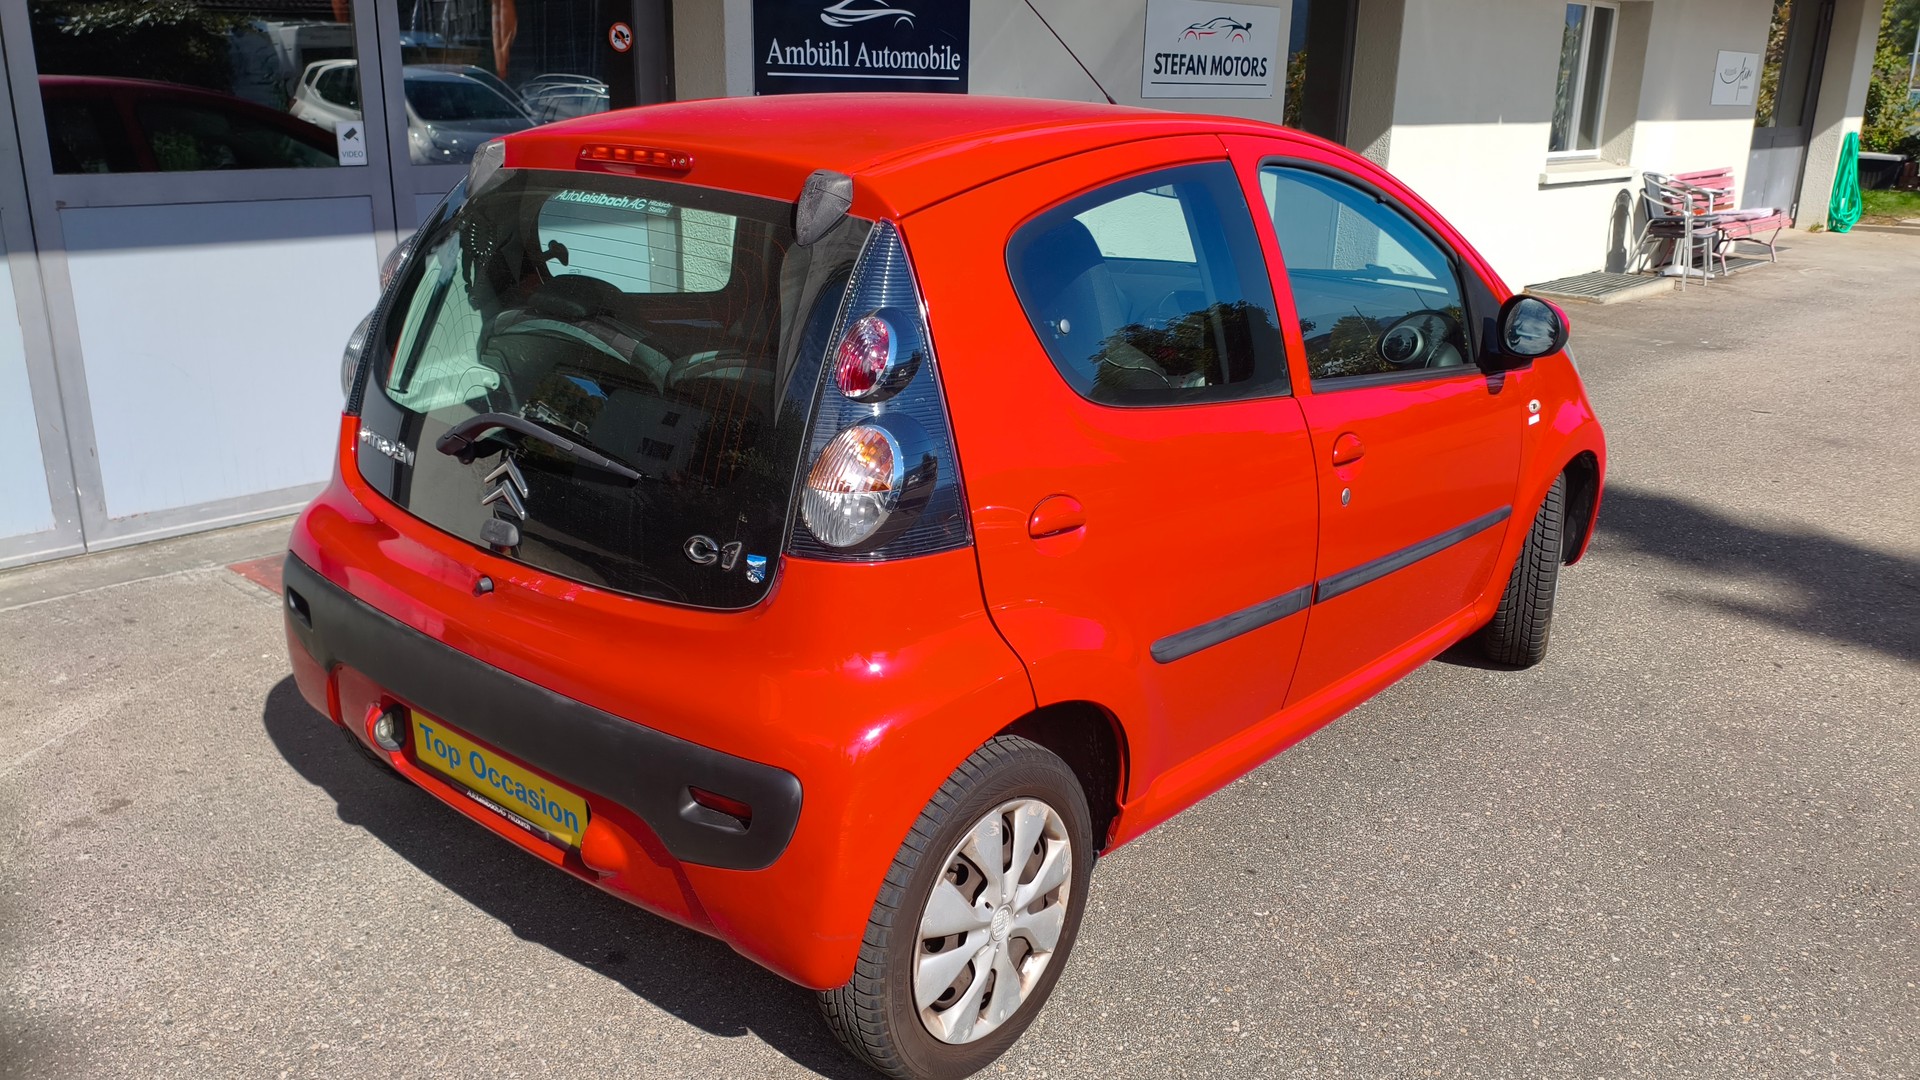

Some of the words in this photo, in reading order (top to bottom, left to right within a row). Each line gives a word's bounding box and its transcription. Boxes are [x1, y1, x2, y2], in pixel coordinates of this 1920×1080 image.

[766, 38, 849, 66] Ambühl
[854, 42, 960, 70] Automobile
[1153, 53, 1207, 75] STEFAN
[1210, 55, 1267, 77] MOTORS
[341, 150, 364, 158] VIDEO
[683, 534, 742, 571] C1
[419, 722, 461, 769] Top
[469, 750, 579, 833] Occasion
